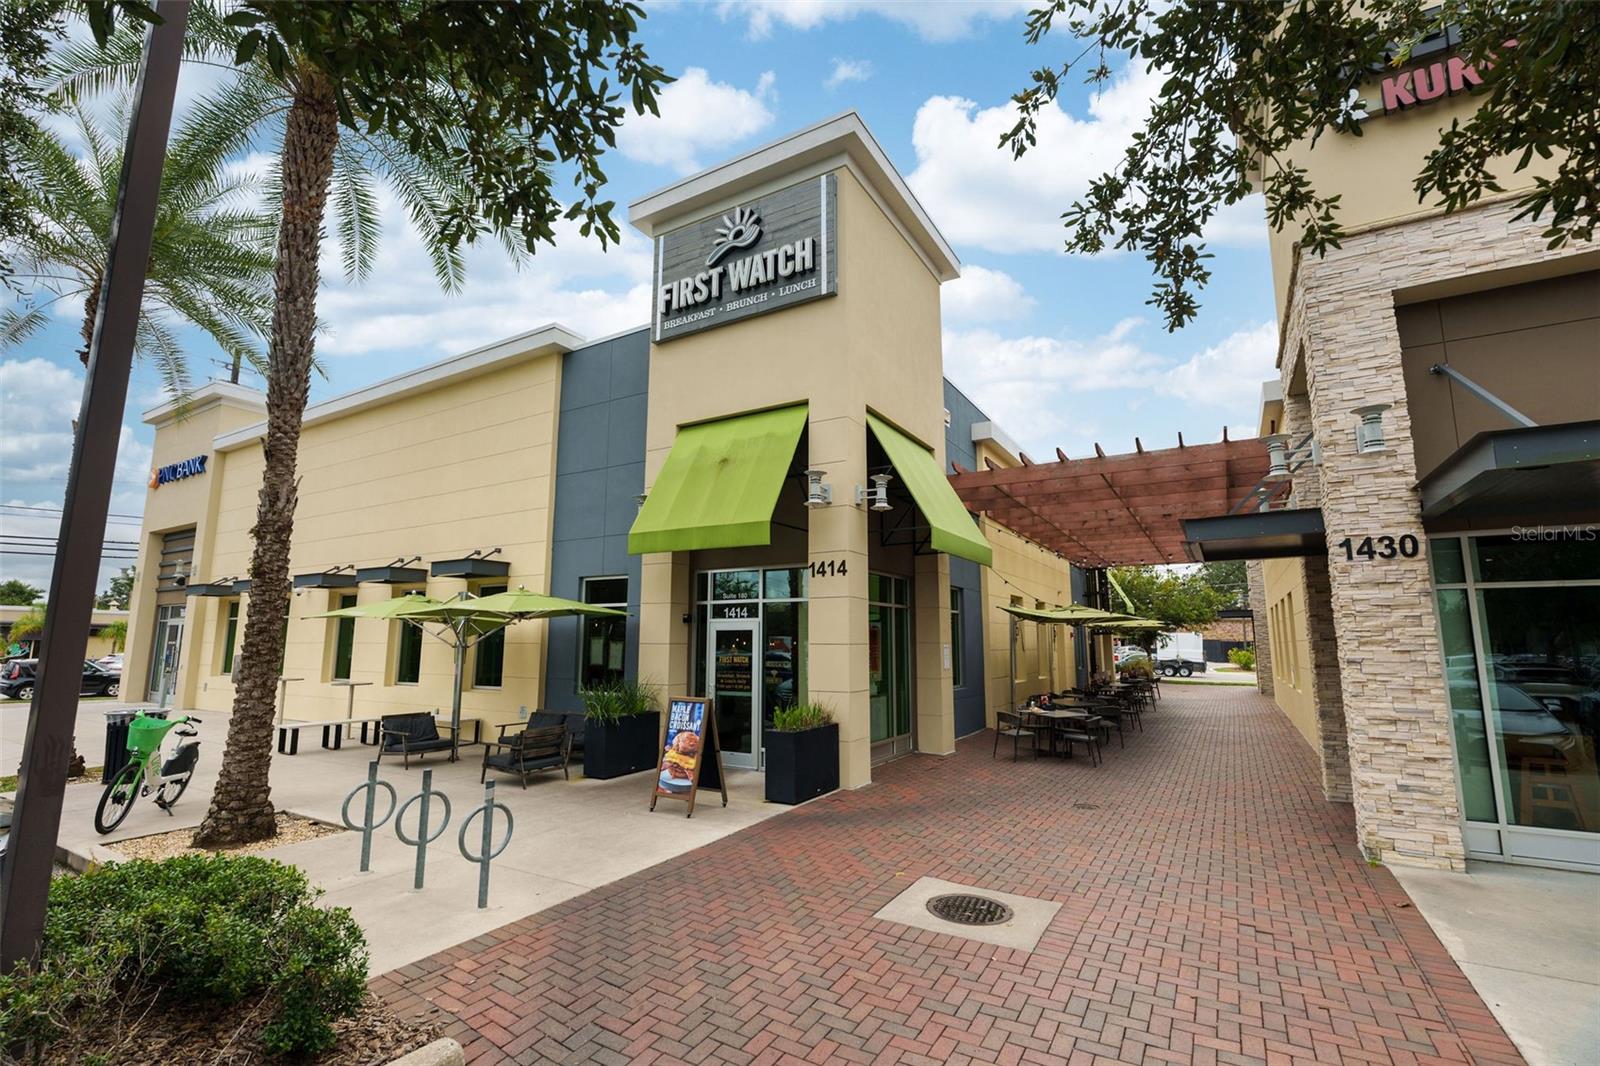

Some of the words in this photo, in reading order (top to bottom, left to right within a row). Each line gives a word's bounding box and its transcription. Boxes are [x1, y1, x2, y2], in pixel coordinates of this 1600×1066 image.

[659, 266, 724, 316] FIRST
[728, 237, 815, 294] WATCH
[664, 307, 717, 330] BREAKFAST
[726, 292, 768, 312] BRUNCH
[779, 277, 817, 297] LUNCH
[158, 464, 176, 485] PNC
[176, 455, 207, 481] BANK
[1338, 533, 1419, 562] 1430
[808, 560, 848, 578] 1414
[722, 592, 737, 600] Suite
[723, 606, 749, 618] 1414
[669, 720, 702, 731] CROISSANT
[670, 712, 690, 722] BACON
